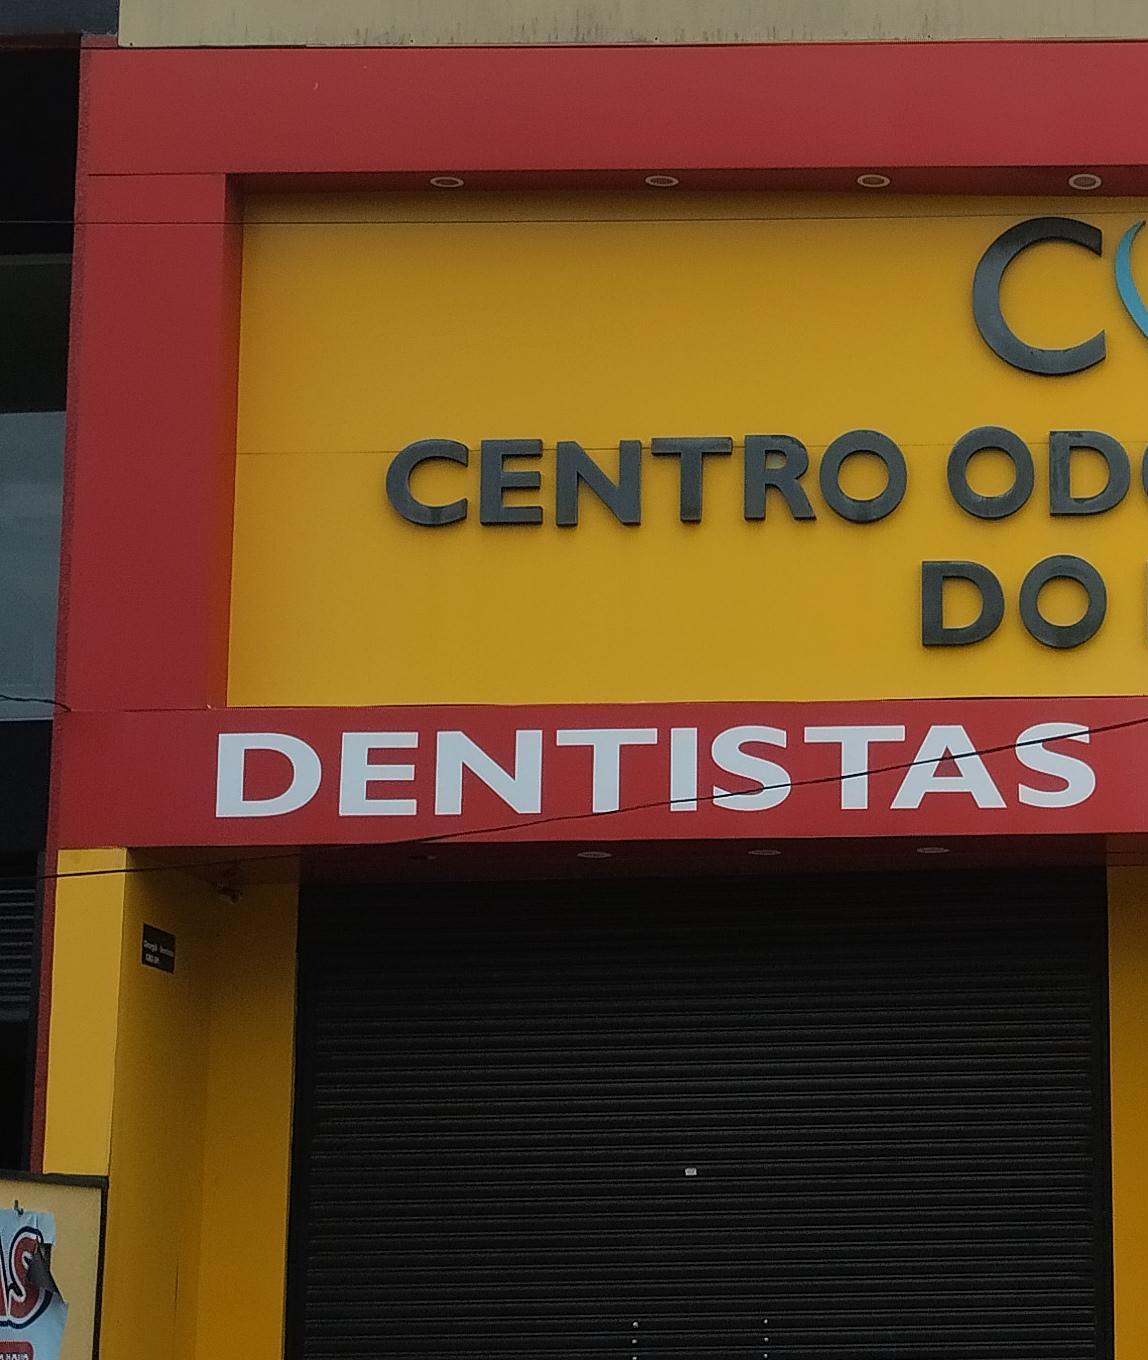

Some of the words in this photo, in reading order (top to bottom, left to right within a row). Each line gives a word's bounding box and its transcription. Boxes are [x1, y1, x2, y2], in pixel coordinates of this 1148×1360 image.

[386, 429, 907, 527] CENTRO
[921, 553, 1107, 649] DO
[215, 722, 1098, 819] DENTISTAS
